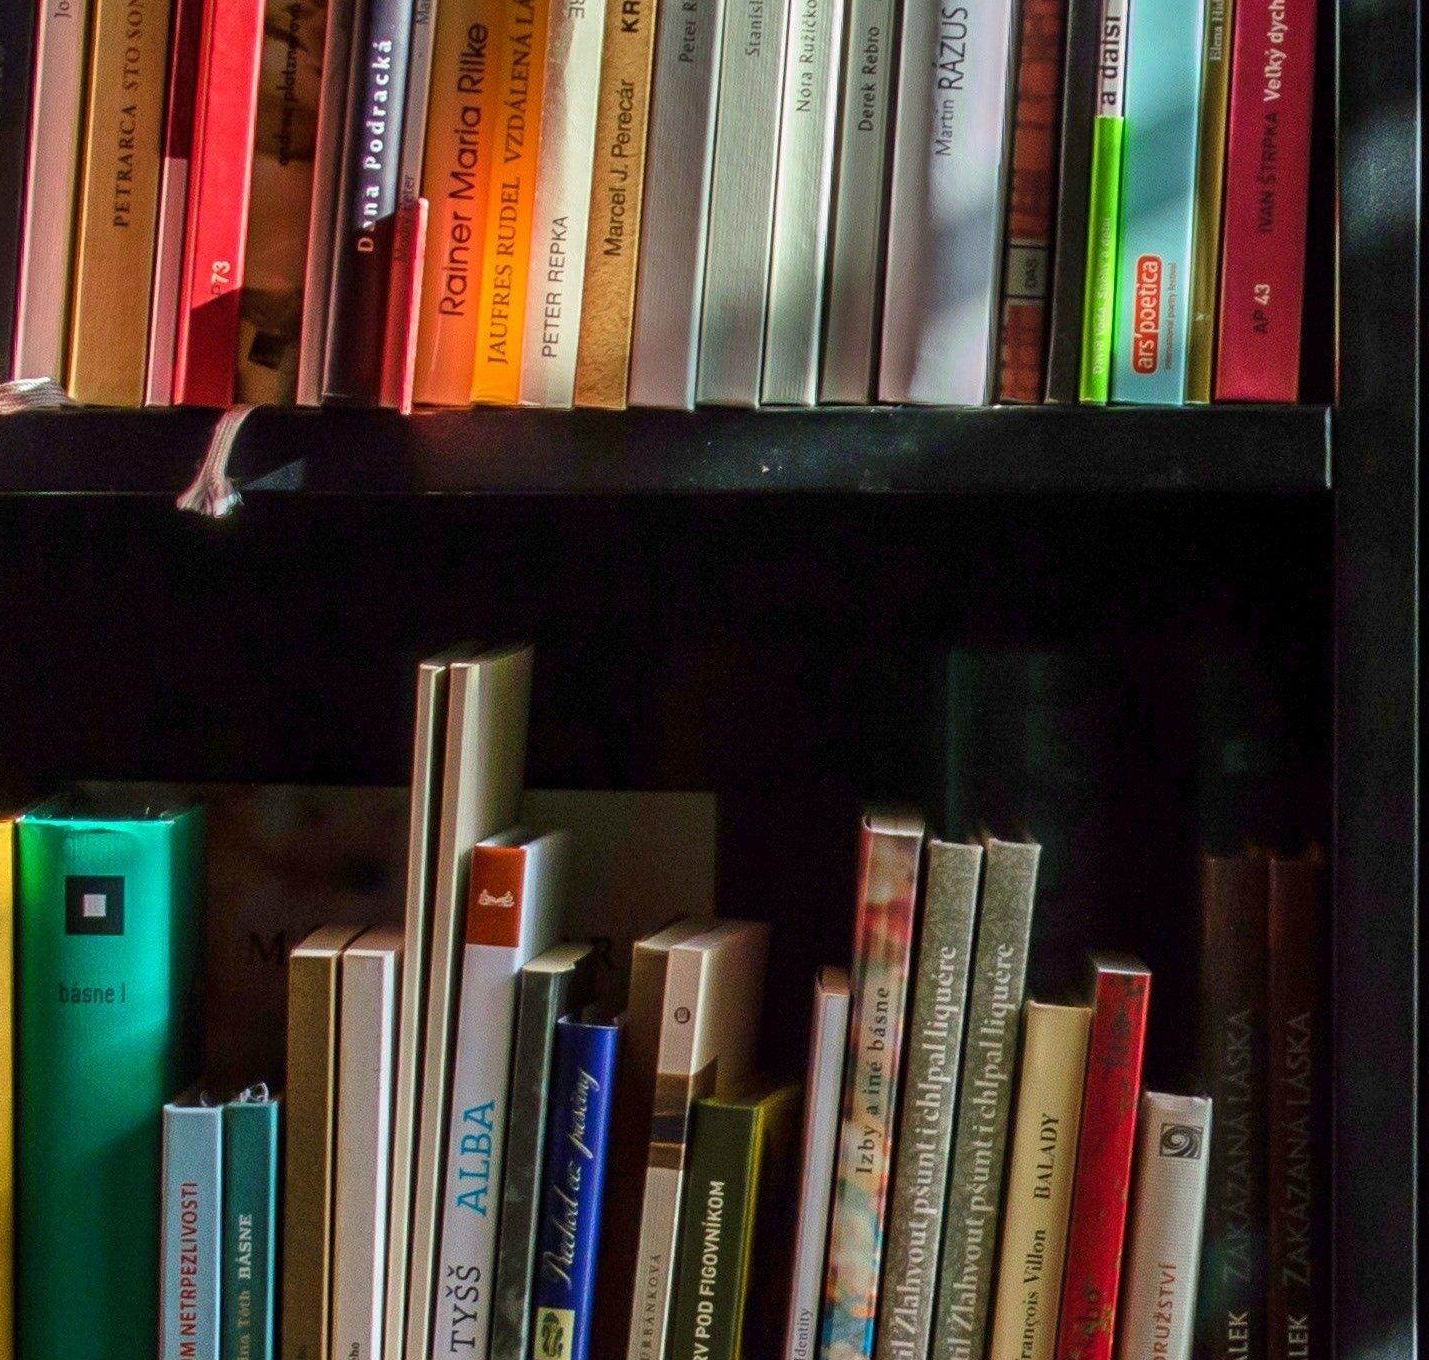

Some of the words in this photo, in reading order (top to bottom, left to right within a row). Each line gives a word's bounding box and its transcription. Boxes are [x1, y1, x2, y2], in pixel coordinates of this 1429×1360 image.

[457, 24, 489, 93] Rilke
[861, 26, 880, 75] Rebro
[932, 7, 968, 90] RÁZUS
[611, 79, 634, 158] Perecár
[858, 83, 875, 132] Derek
[935, 99, 954, 156] Martin
[448, 105, 482, 200] Maria
[611, 164, 629, 181] J.
[496, 177, 520, 256] RUDEL
[547, 216, 569, 283] REPKA
[604, 187, 625, 257] Marcel
[439, 211, 473, 317] Rainer
[487, 264, 513, 364] JAUFRES
[541, 292, 561, 358] PETER
[456, 1101, 495, 1217] ALBA
[444, 1264, 482, 1353] TYŠŠ
